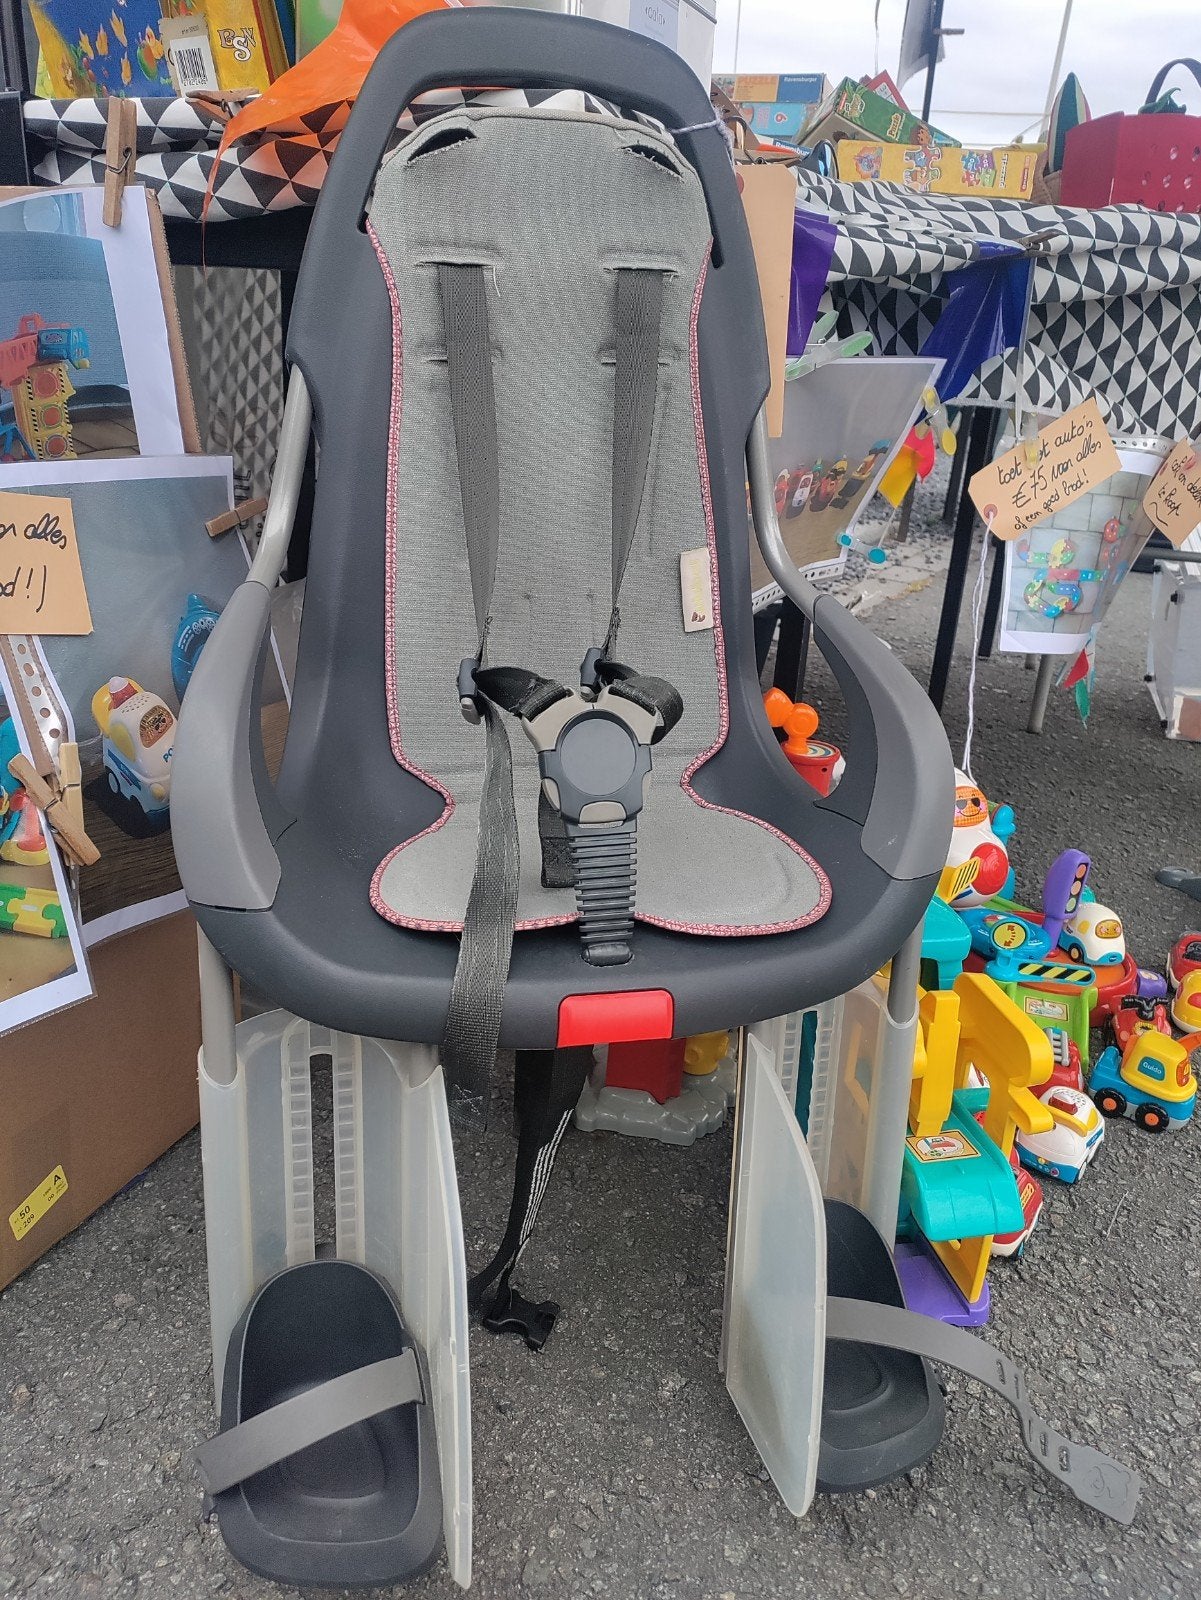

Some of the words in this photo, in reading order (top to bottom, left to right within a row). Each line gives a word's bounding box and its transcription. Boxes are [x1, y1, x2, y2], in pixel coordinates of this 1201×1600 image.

[1076, 433, 1102, 462] alles
[24, 512, 67, 549] alles
[1014, 516, 1027, 530] of
[1026, 511, 1042, 522] een
[1143, 1061, 1162, 1074] Guido
[20, 1205, 30, 1220] 50
[54, 1174, 62, 1186] A
